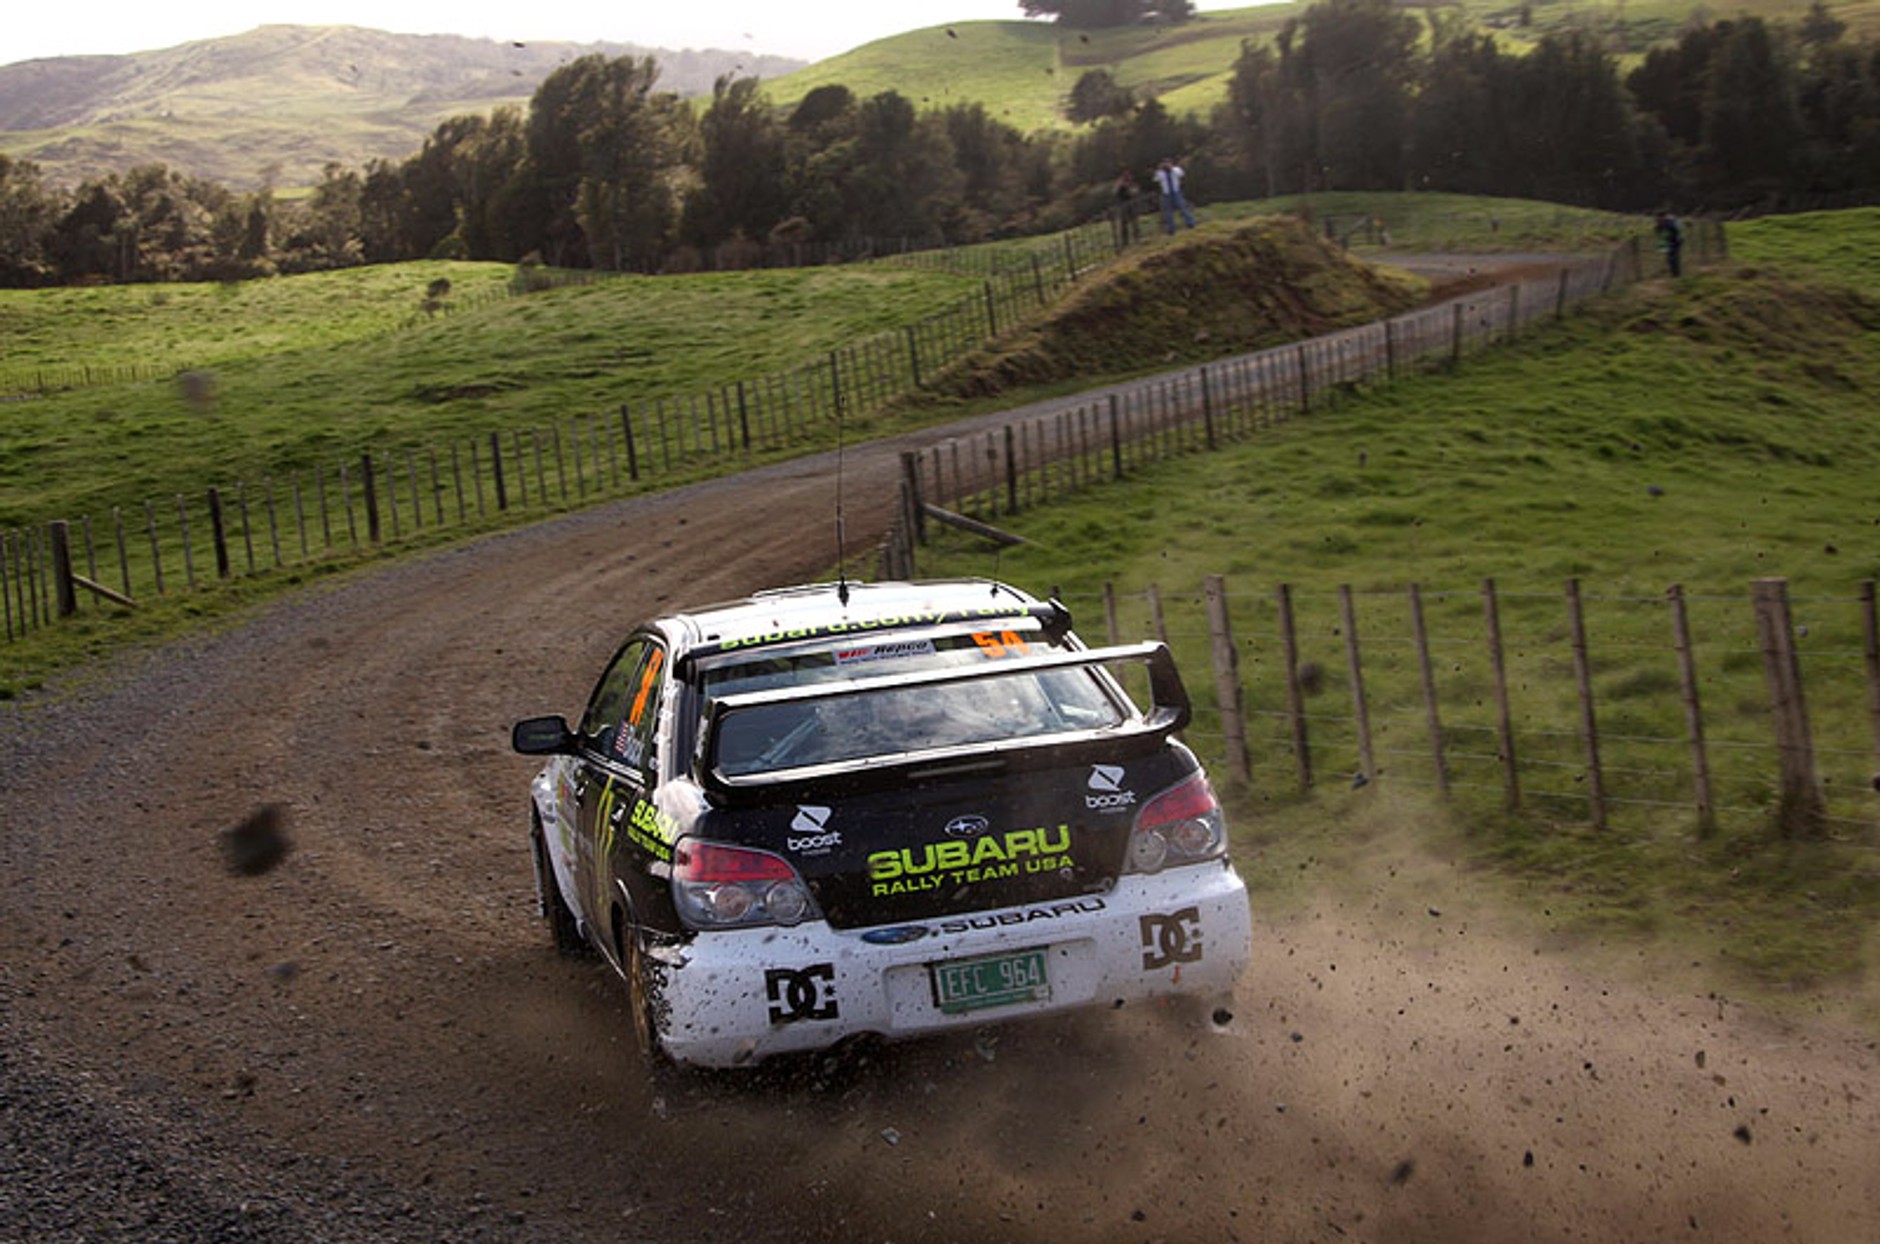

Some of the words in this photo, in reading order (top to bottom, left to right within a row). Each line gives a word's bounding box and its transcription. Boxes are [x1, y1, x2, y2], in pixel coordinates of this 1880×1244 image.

[971, 630, 1031, 658] 54
[1085, 790, 1136, 808] boost
[787, 831, 842, 851] boost
[867, 825, 1071, 880] SUBARU
[872, 874, 944, 897] RALLY
[951, 863, 1019, 884] TEAM
[1026, 855, 1074, 873] USA
[940, 898, 1106, 934] SUBARU
[1138, 906, 1202, 971] DC
[764, 962, 839, 1025] DC
[946, 966, 988, 997] EFC
[1000, 957, 1041, 988] 964
